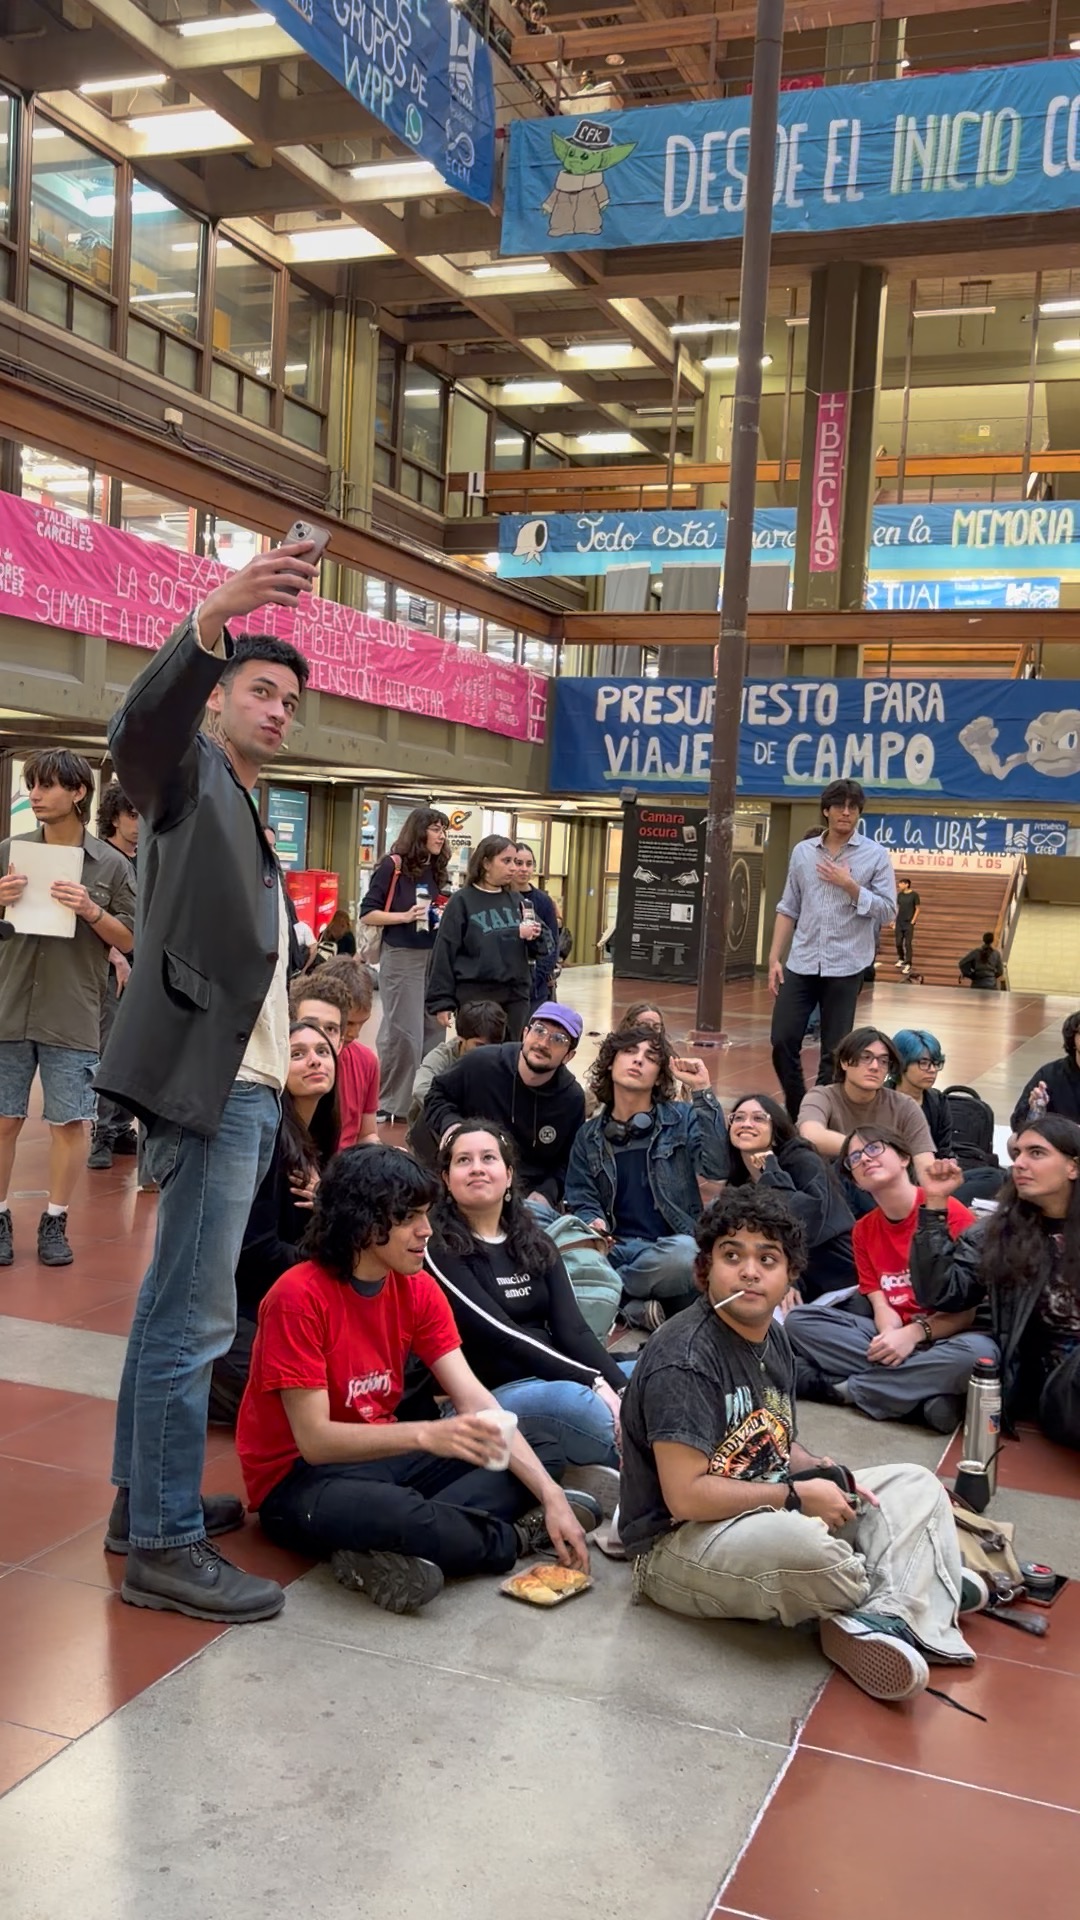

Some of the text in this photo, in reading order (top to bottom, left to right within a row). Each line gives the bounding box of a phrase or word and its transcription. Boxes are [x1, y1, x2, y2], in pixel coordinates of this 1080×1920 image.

[332, 0, 407, 88] GRUPOS
[410, 63, 428, 107] DE
[343, 33, 393, 123] WPP
[578, 126, 603, 142] CFK
[823, 118, 864, 204] EL
[890, 106, 1022, 195] INICIO
[814, 421, 842, 566] BECAS
[43, 508, 80, 532] TALLER
[576, 516, 643, 553] Todo
[652, 520, 717, 549] está
[872, 526, 901, 547] en
[907, 514, 934, 544] la
[951, 507, 1075, 549] MEMORIA
[36, 521, 94, 553] CARCELES
[116, 563, 138, 601] LA
[292, 617, 376, 670] AMBIENTE
[35, 584, 115, 637] SUMATE
[119, 608, 130, 644] A
[136, 613, 166, 651] LOS
[307, 658, 373, 701] TENSION
[385, 678, 447, 719] BIENESTAR
[595, 681, 945, 726] PRESUESTO PARA
[753, 741, 778, 765] DE
[786, 731, 935, 786] CAMPO
[639, 810, 685, 825] Camara
[639, 826, 678, 839] oscura
[874, 818, 897, 844] de
[903, 819, 924, 846] la
[934, 821, 974, 851] UBA
[899, 854, 1002, 869] CASTIGO A LOS
[470, 907, 521, 935] YAL
[496, 1273, 531, 1286] mucho
[504, 1286, 532, 1299] amor
